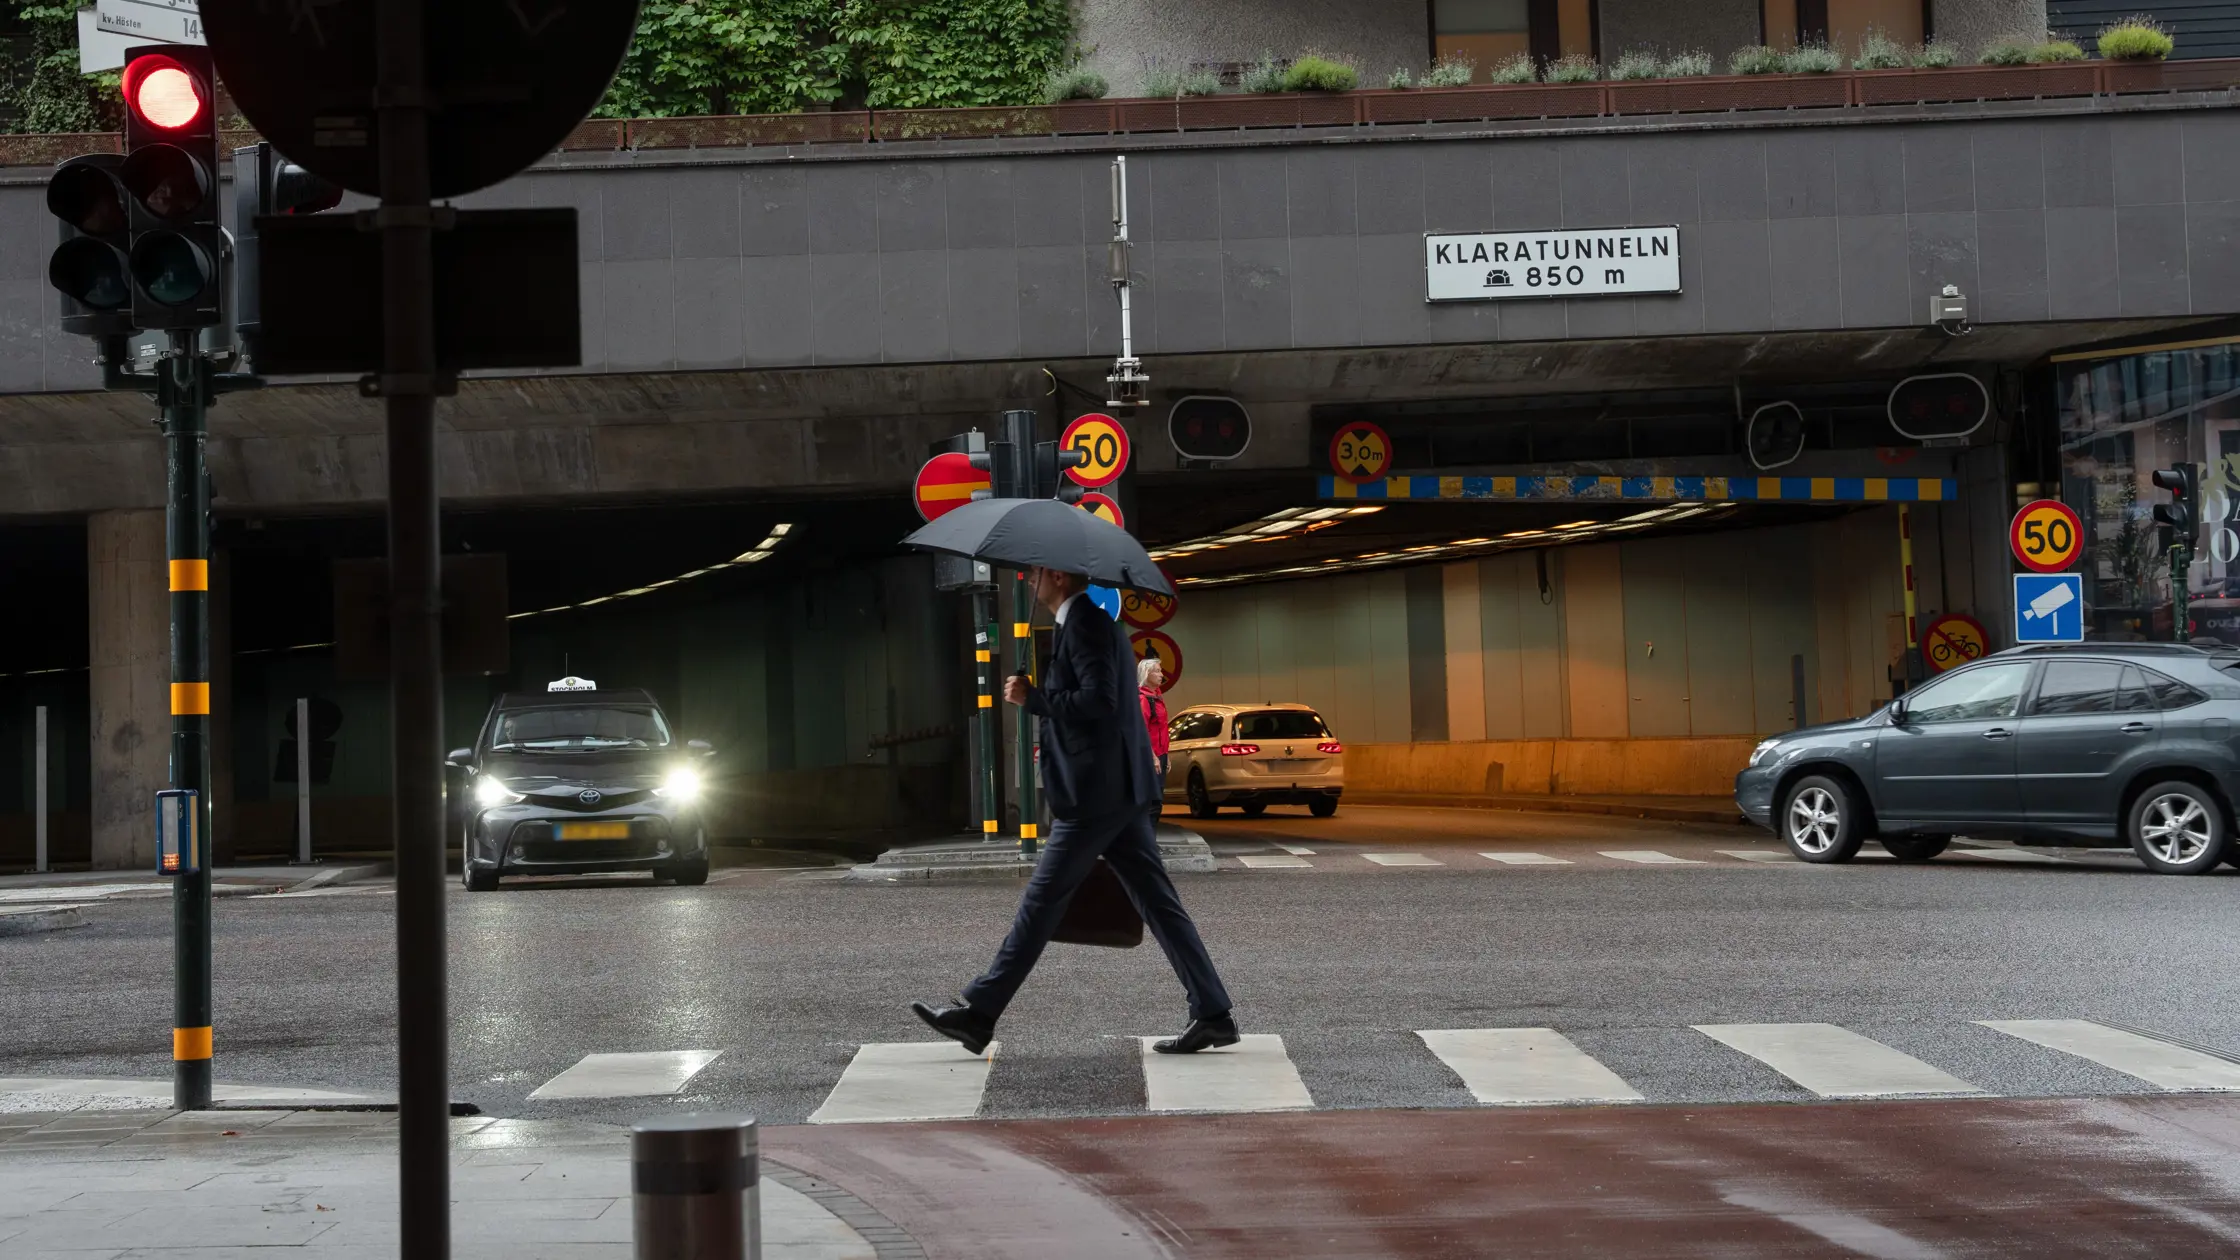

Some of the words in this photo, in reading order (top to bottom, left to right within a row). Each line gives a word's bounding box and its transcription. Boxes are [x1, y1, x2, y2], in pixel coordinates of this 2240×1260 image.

[102, 12, 114, 24] kv.
[1436, 236, 1669, 264] KLARATUNNELN
[1526, 265, 1584, 287] 850
[1605, 268, 1625, 284] m
[1073, 433, 1117, 469] 50
[2025, 519, 2071, 554] 50
